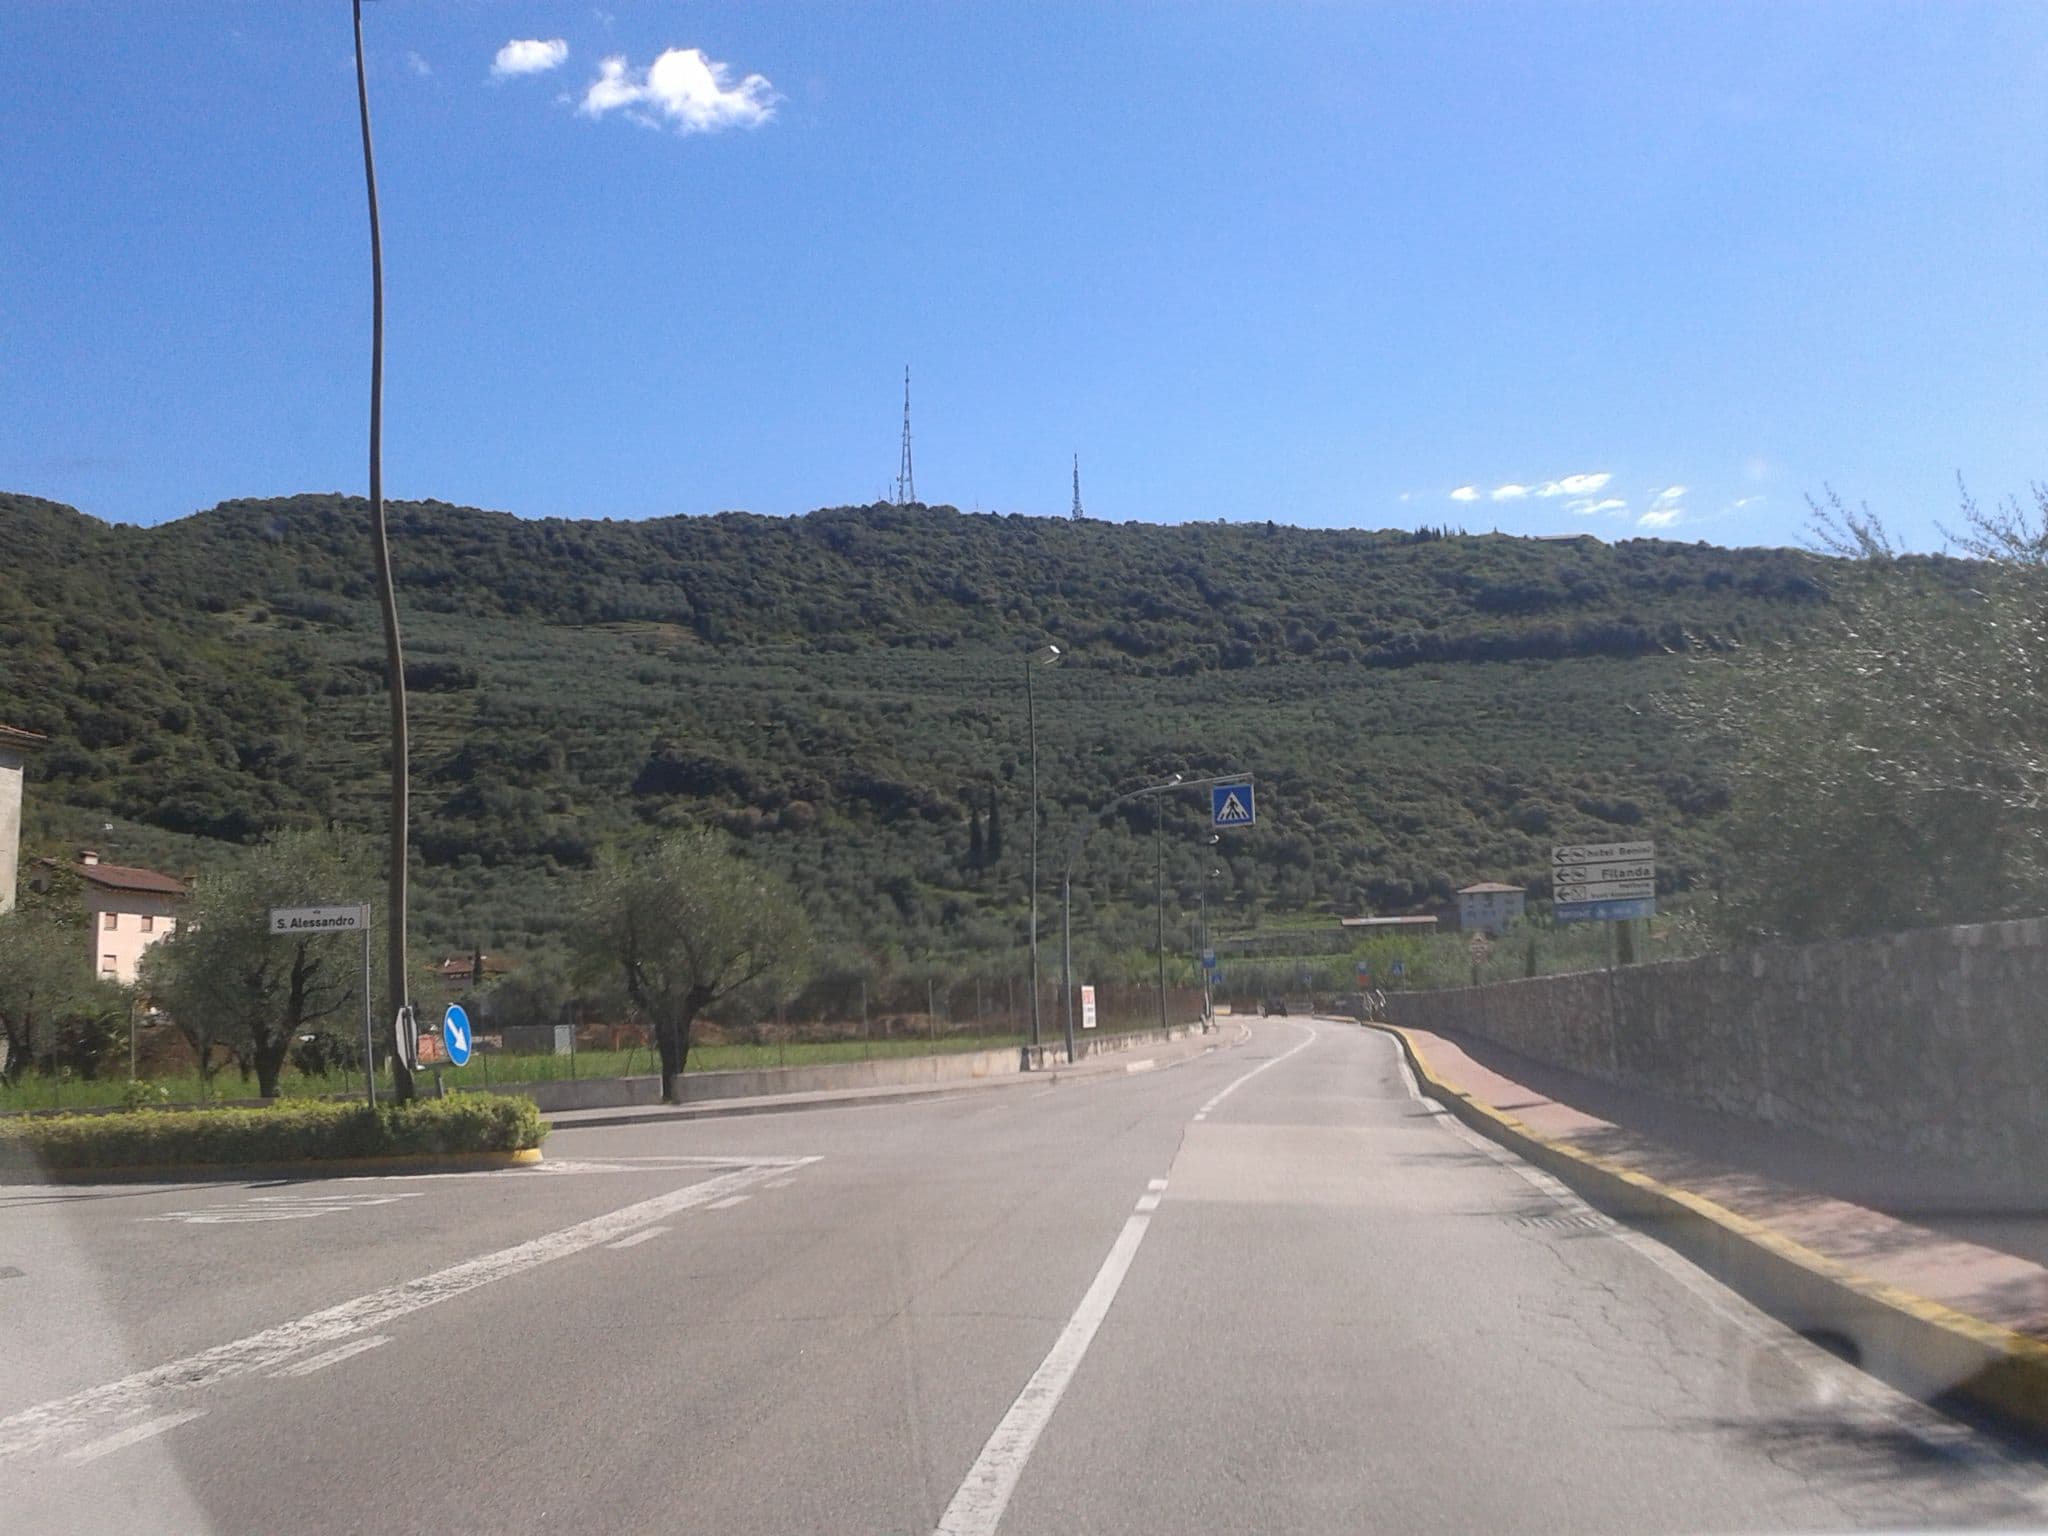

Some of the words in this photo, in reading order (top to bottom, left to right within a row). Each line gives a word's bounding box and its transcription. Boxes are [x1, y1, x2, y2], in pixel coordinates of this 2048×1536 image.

[1601, 867, 1650, 879] Filanda
[277, 918, 288, 929] S.
[290, 915, 355, 929] Alessandro
